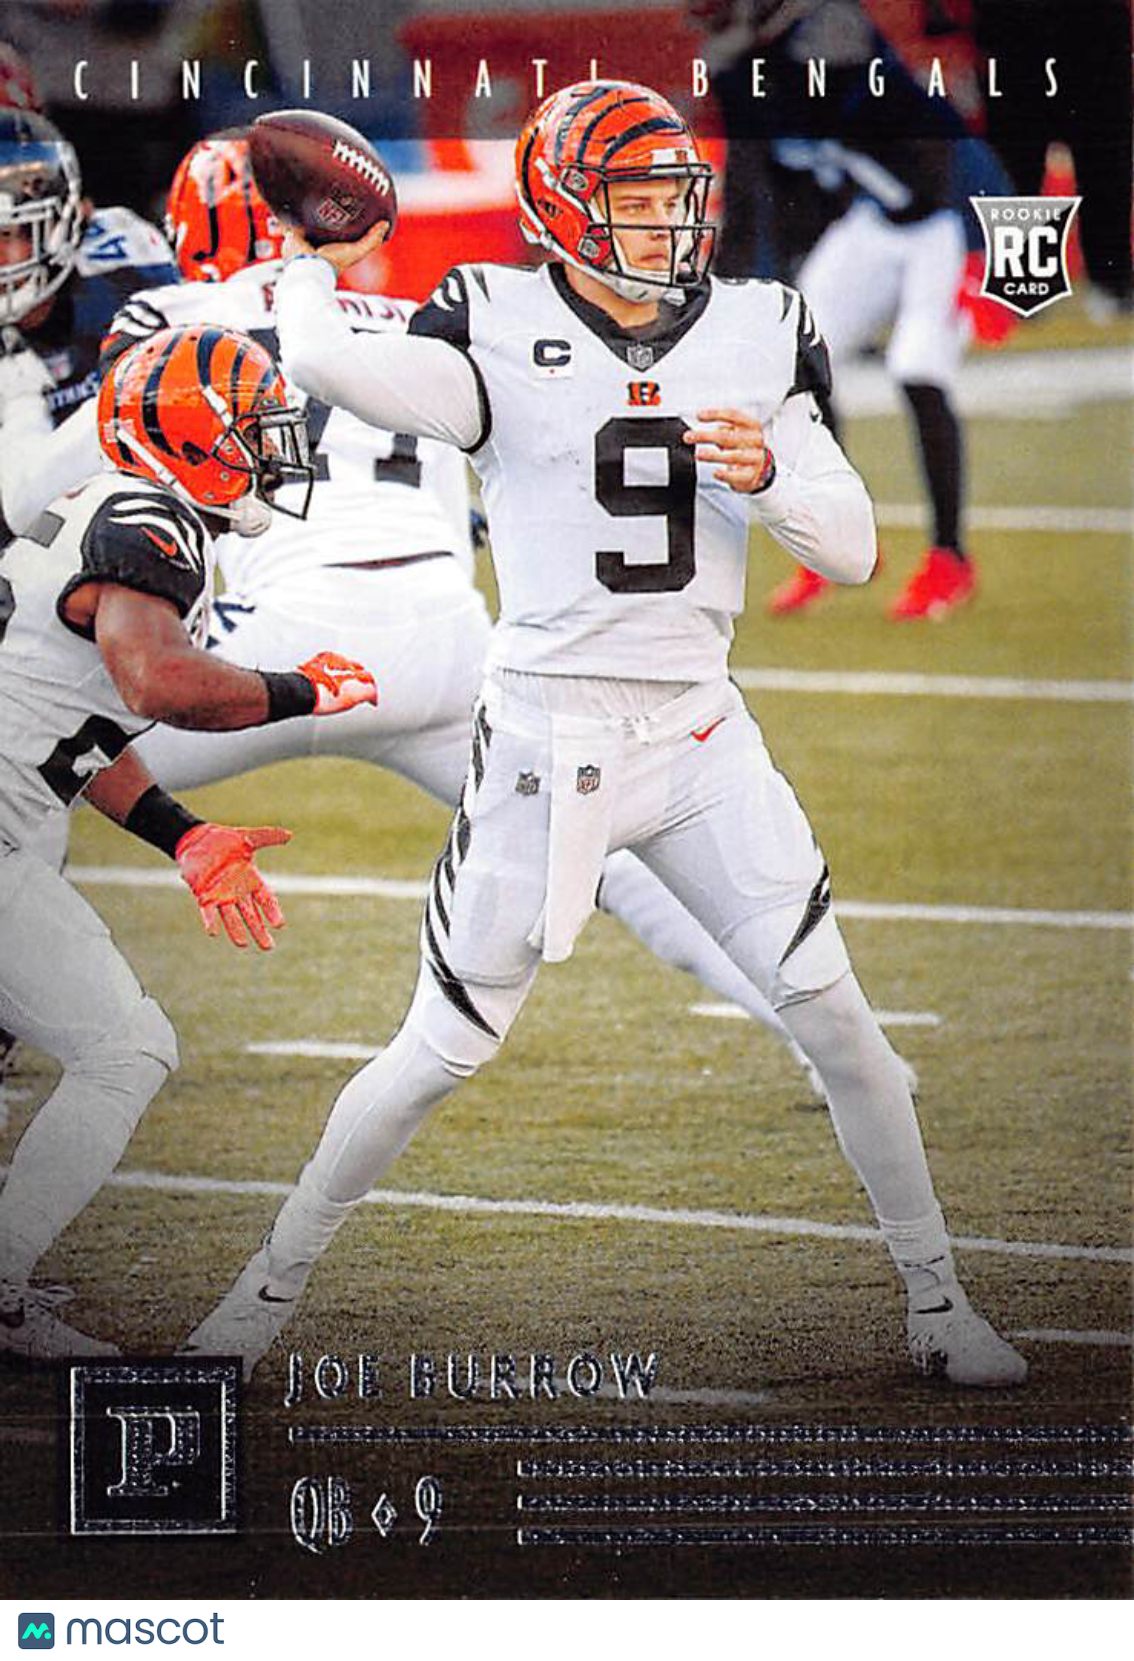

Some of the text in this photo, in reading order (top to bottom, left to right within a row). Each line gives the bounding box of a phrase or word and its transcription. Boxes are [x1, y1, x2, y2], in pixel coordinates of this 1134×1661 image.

[75, 58, 1059, 99] CINCINNATI BENGALS
[990, 208, 1062, 221] ROOKIE
[994, 226, 1059, 278] RC
[1003, 282, 1050, 296] CARD
[533, 339, 572, 367] C
[594, 416, 698, 594] 9
[284, 1352, 661, 1407] JOE BURROW
[290, 1475, 444, 1554] QB 9
